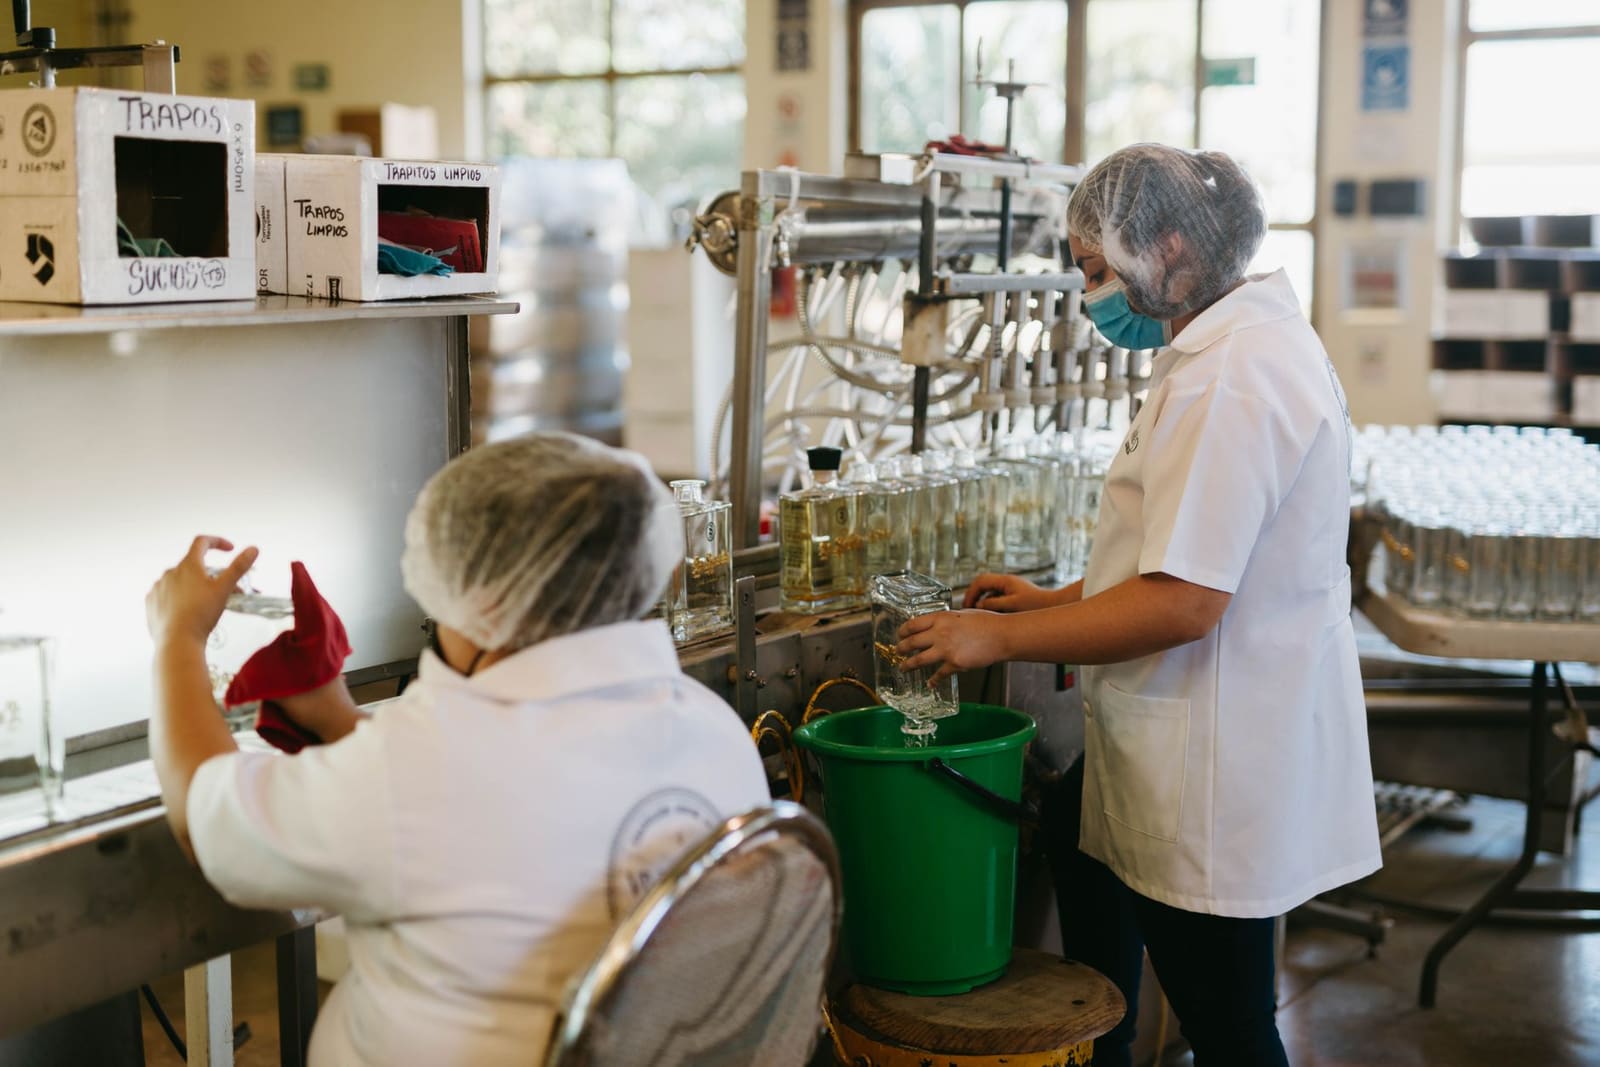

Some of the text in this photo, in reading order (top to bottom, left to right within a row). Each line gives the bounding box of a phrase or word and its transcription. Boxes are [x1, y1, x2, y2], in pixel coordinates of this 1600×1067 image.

[118, 96, 221, 134] TRAPOS
[233, 123, 242, 132] 6
[383, 162, 482, 181] TRAPITOS LIMPIOS
[293, 199, 345, 222] TRAPOS
[307, 221, 348, 238] LIMPIOS
[128, 259, 198, 296] SUCIOS
